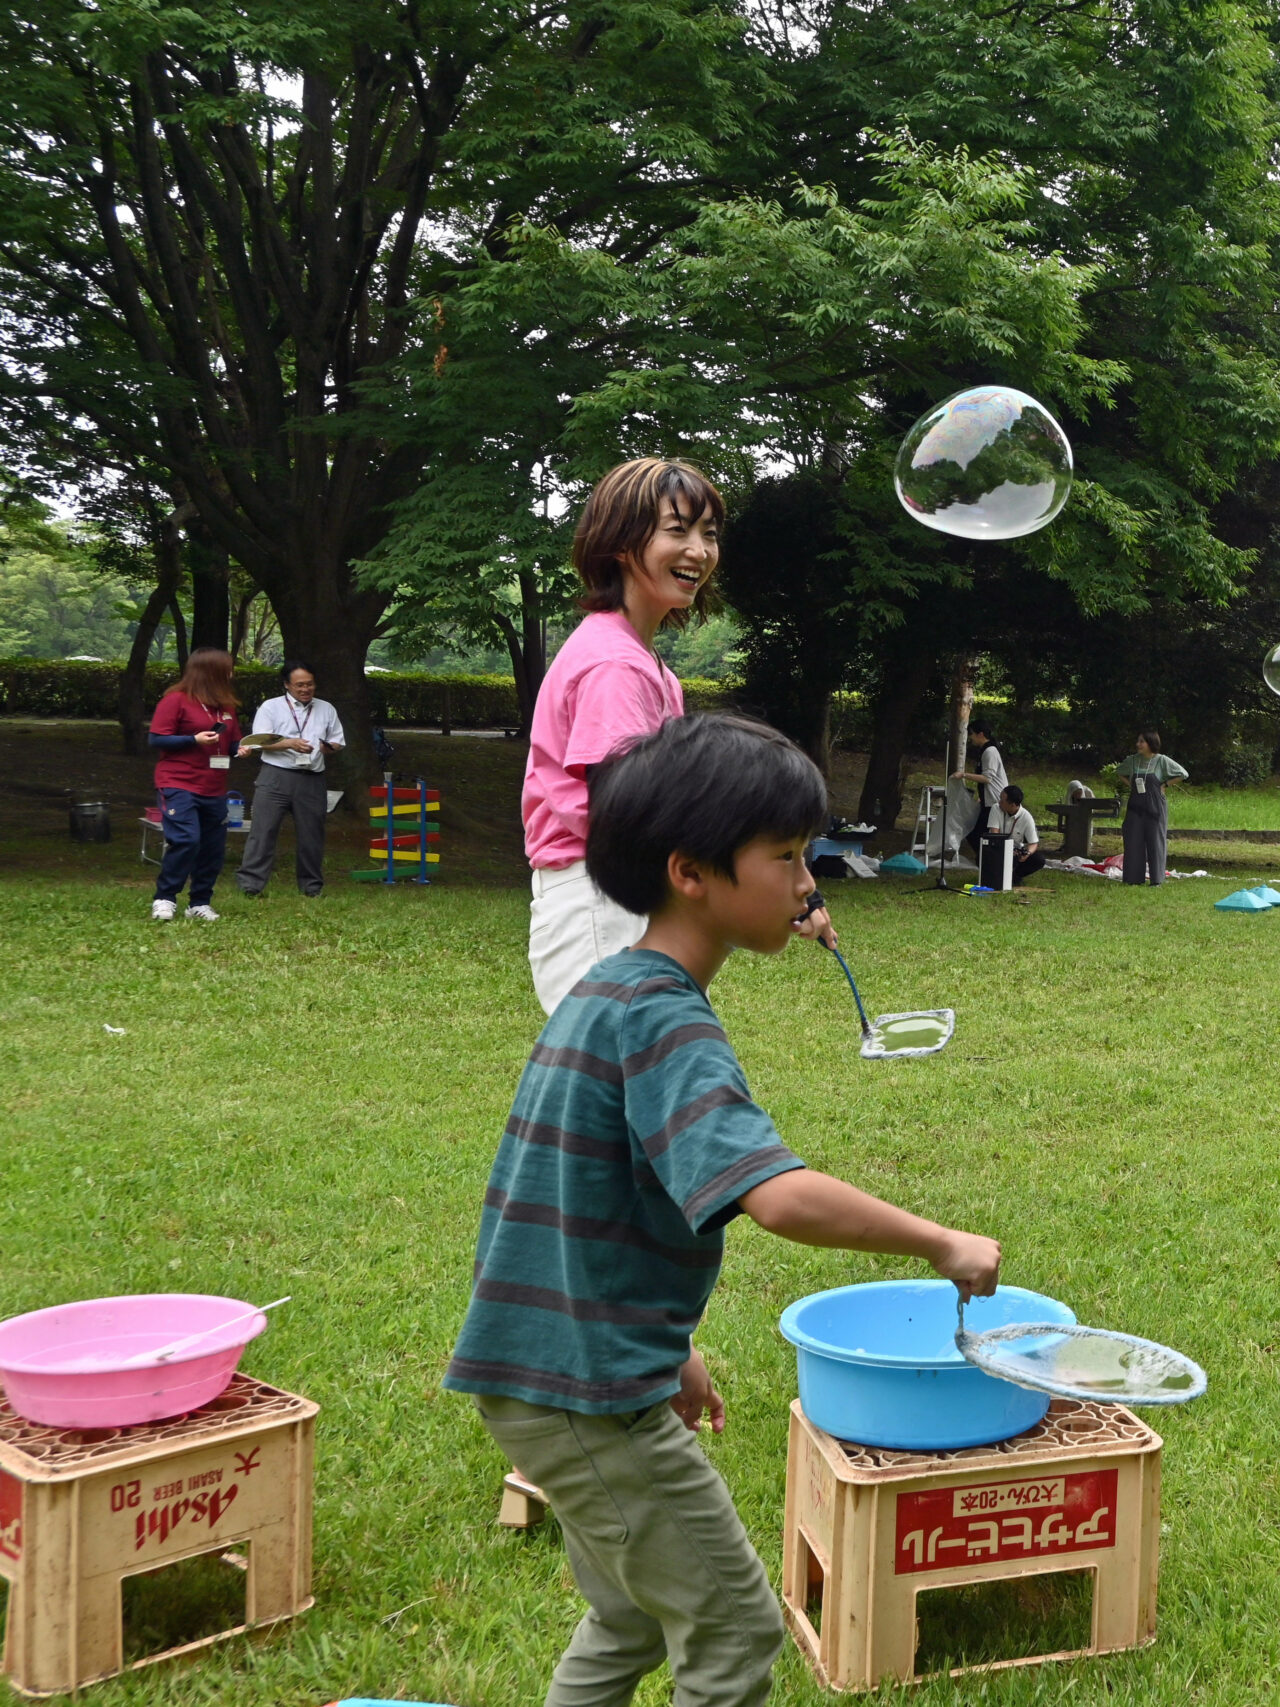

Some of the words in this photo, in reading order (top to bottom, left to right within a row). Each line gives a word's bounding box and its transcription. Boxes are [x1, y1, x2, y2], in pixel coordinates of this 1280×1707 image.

[233, 1446, 261, 1476] 大
[153, 1479, 183, 1501] BEER
[188, 1467, 223, 1491] ASAHI
[111, 1479, 142, 1512] 20
[960, 1483, 1059, 1512] 大びん・20本
[135, 1483, 239, 1551] Asahi
[902, 1507, 1109, 1565] アサヒビール
